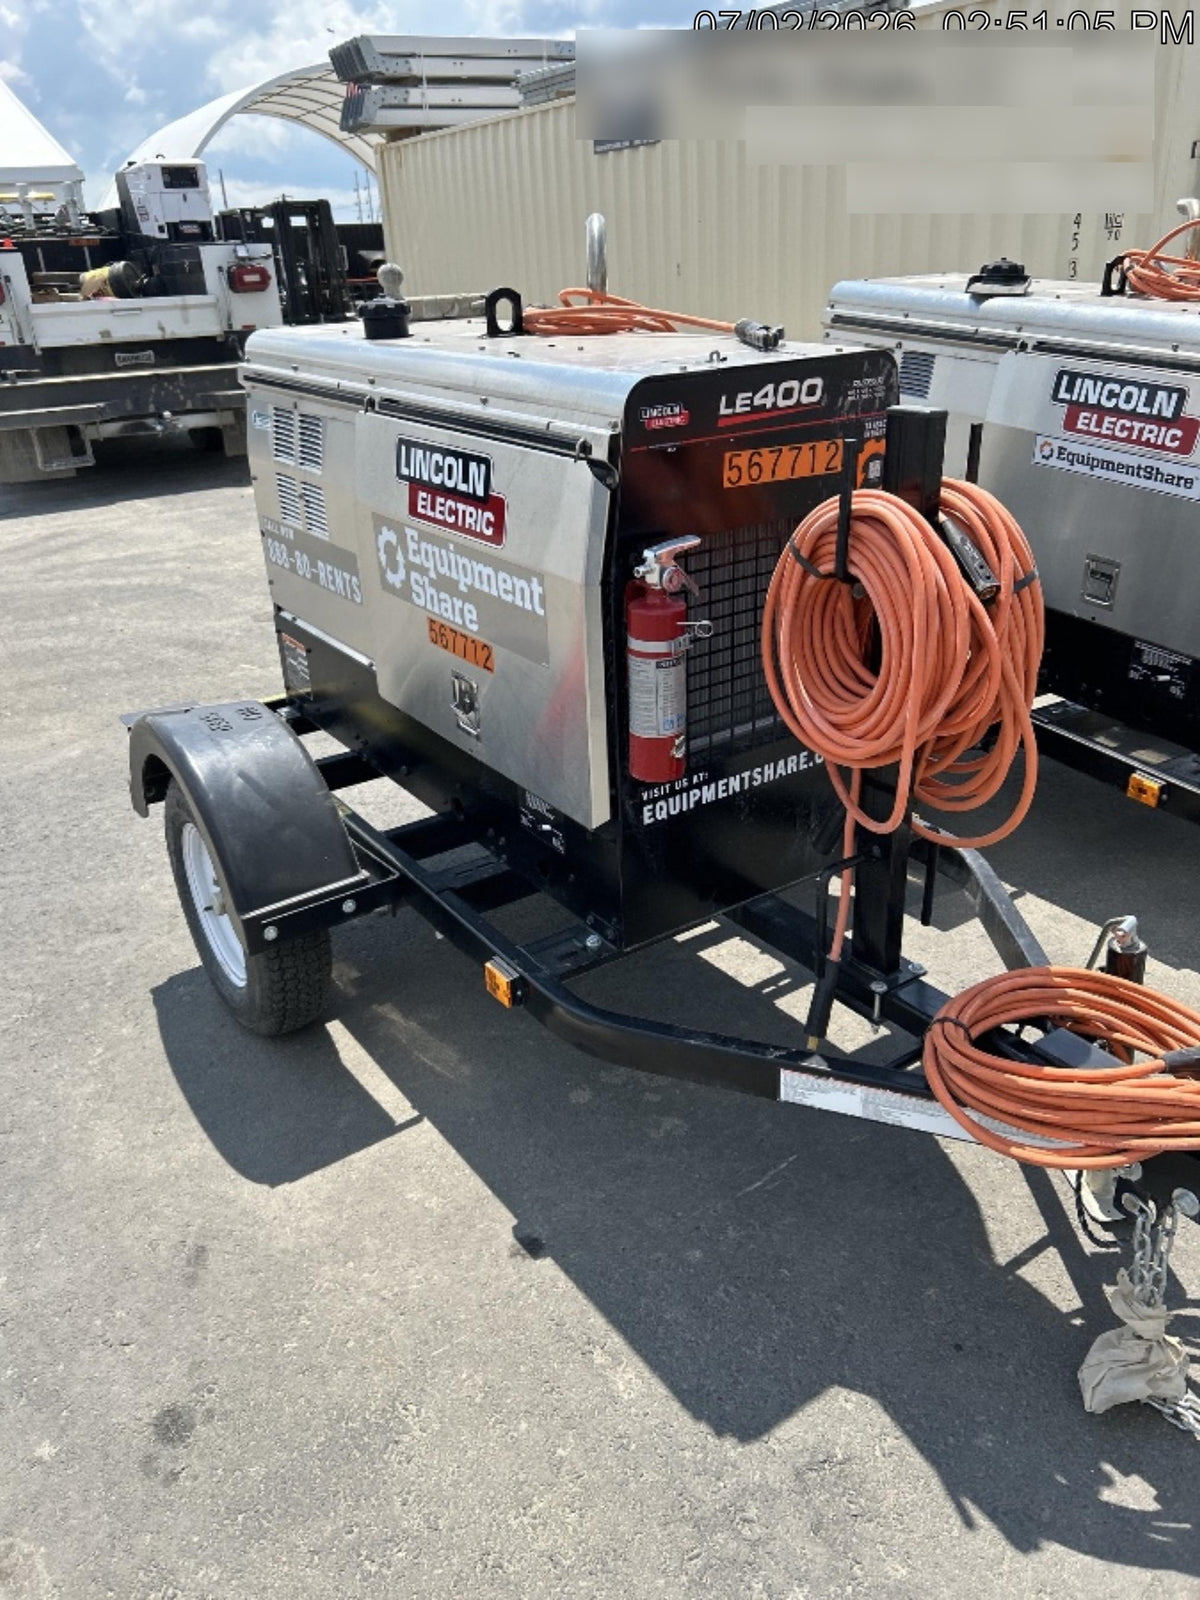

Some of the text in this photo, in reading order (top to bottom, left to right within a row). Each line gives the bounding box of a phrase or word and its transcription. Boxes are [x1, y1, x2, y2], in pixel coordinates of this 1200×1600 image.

[642, 405, 680, 418] LINCOLN
[719, 377, 824, 415] LE400
[1057, 375, 1178, 418] LINCOLN
[1076, 412, 1183, 448] ELECTRIC
[400, 445, 487, 497] LINCOLN
[727, 440, 839, 486] 567712
[1056, 446, 1194, 489] EquipmentShare
[417, 490, 495, 536] ELECTRIC
[405, 527, 545, 616] Equipment
[410, 571, 479, 632] Share
[429, 619, 493, 672] 567712
[641, 772, 708, 801] VISIT US AT:
